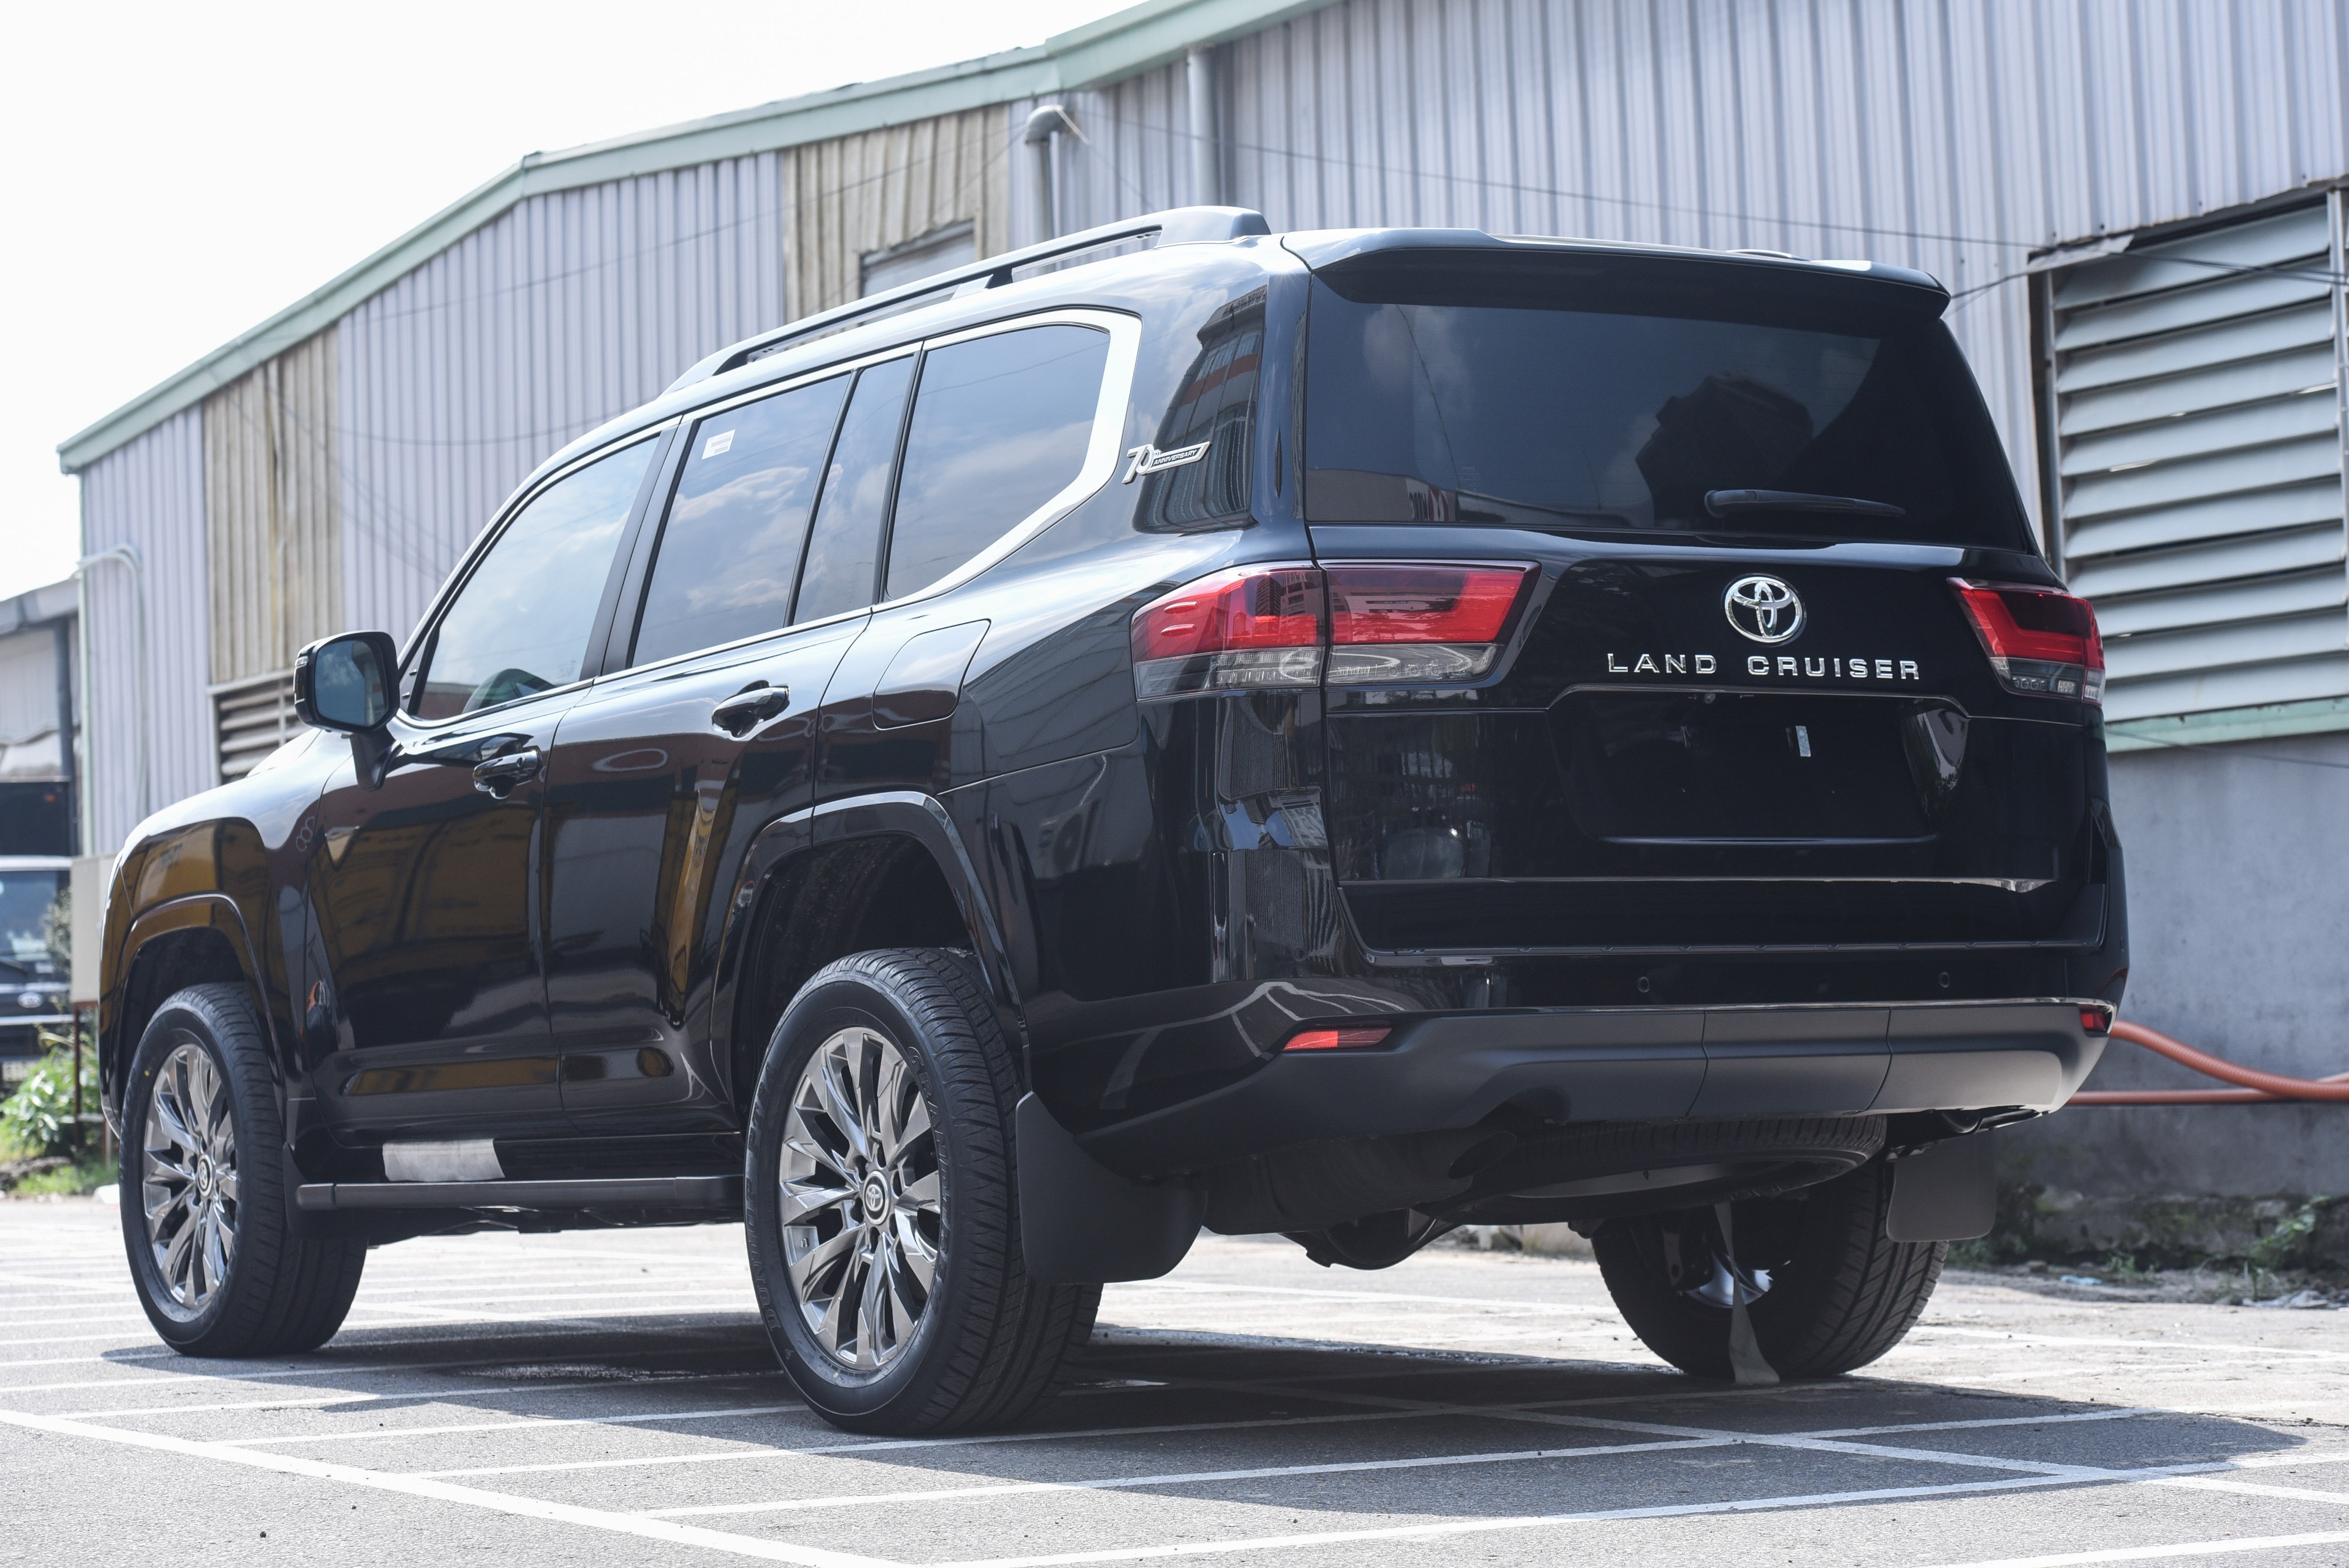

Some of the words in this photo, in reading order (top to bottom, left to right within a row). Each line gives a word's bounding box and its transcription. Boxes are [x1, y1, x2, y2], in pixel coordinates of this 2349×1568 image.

[1153, 449, 1198, 466] ANNIVERSARY
[1607, 652, 1717, 674] LAND
[1747, 655, 1919, 679] CRUISER
[746, 1177, 781, 1331] DUNLOP
